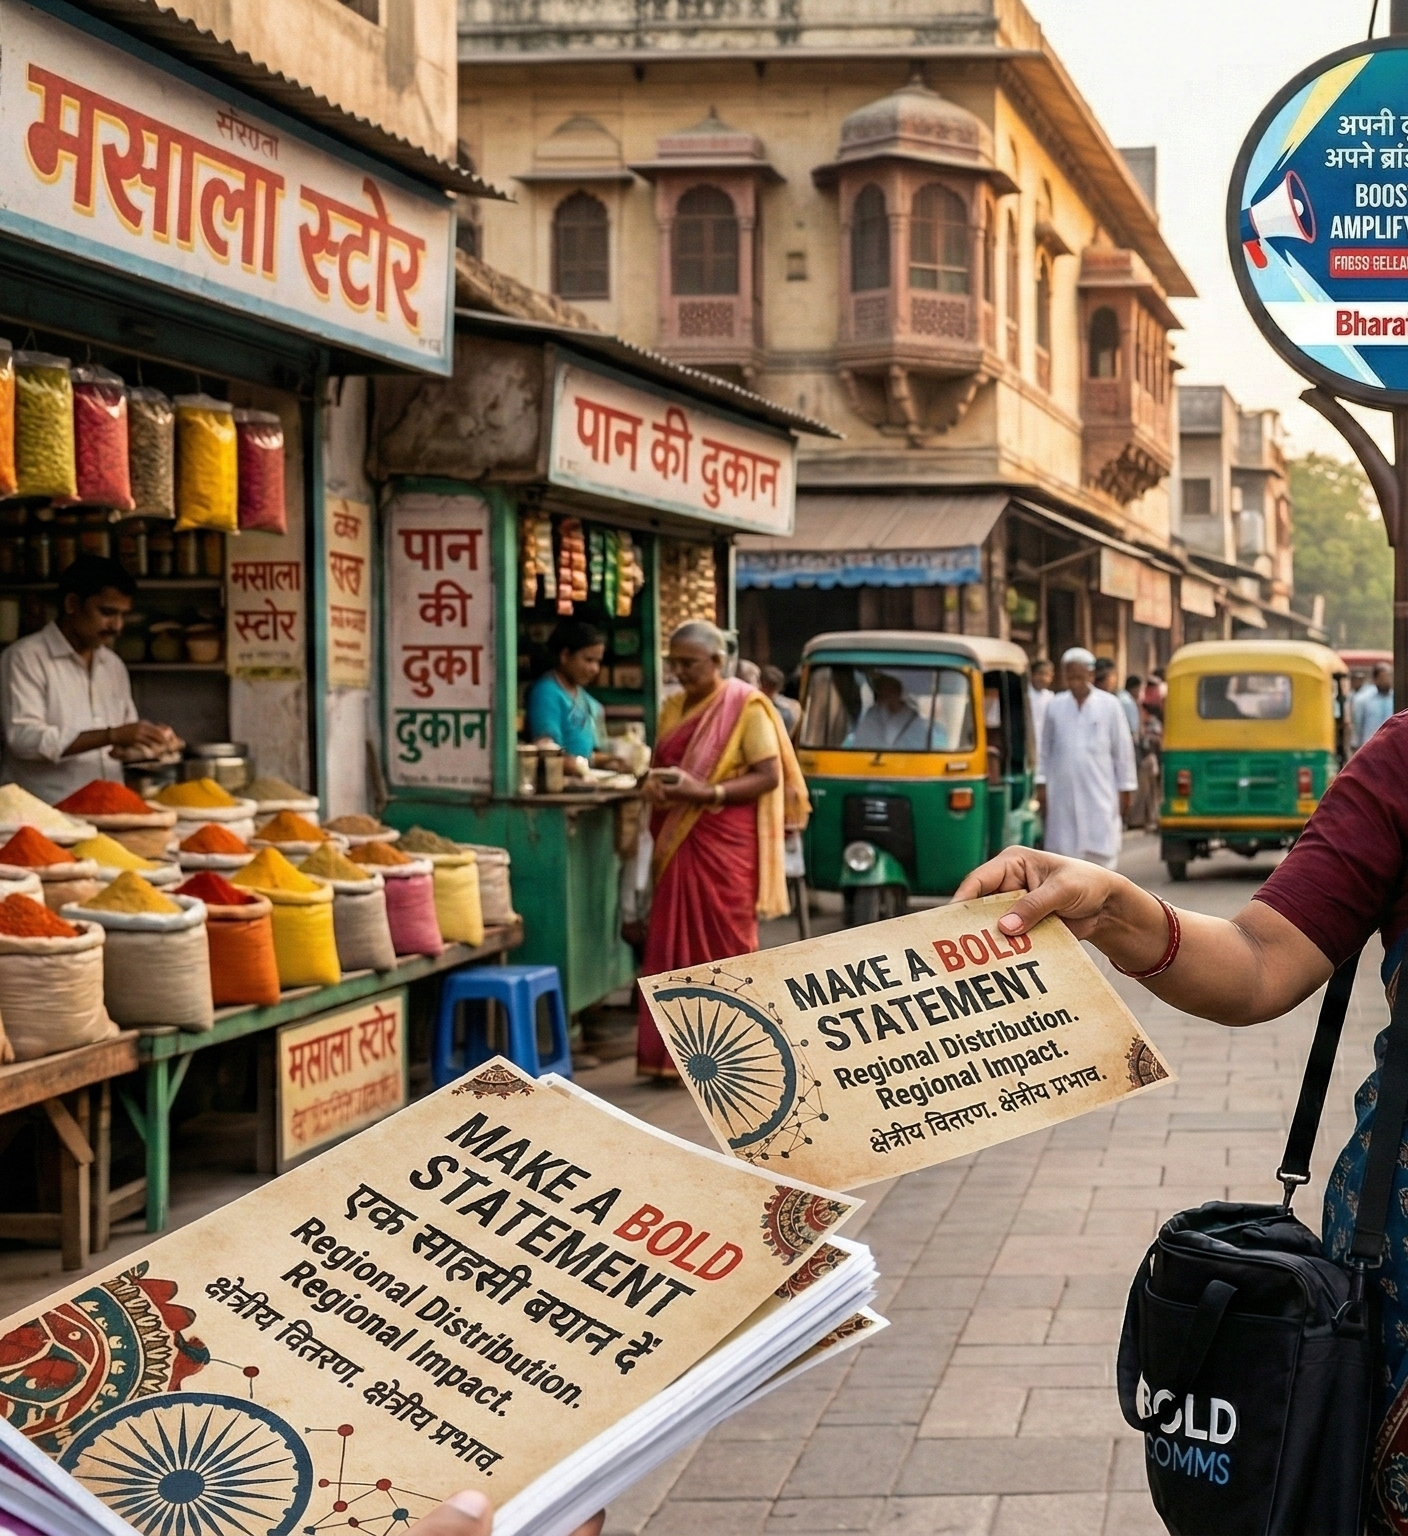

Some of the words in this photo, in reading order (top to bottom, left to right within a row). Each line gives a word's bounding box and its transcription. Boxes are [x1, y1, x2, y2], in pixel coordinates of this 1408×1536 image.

[1324, 141, 1375, 169] अपने
[1337, 107, 1396, 136] अपनी
[26, 63, 285, 281] मसाला
[299, 177, 426, 334] स्टोर
[574, 396, 643, 472] पान
[651, 405, 693, 484] की
[701, 437, 781, 509] दुकान
[231, 561, 301, 592] मसाला
[398, 528, 483, 571] पान
[234, 598, 297, 642] स्टोर
[418, 580, 473, 628] की
[402, 645, 484, 698] दुका
[394, 708, 491, 763] दुकान
[784, 954, 902, 1011] MAKE
[904, 948, 937, 982] A
[932, 929, 1033, 973] BOLD
[817, 960, 1050, 1052] STATEMENT
[288, 1026, 353, 1088] मसाला
[358, 1005, 397, 1067] स्टोर
[833, 1041, 940, 1090] Regional
[939, 1006, 1080, 1059] Distribution.
[876, 1061, 982, 1111] Regional
[986, 1040, 1069, 1078] Impact.
[869, 1121, 926, 1155] क्षेत्रीय
[924, 1102, 998, 1136] वितरण.
[1049, 1066, 1108, 1096] प्रभाव.
[410, 1155, 697, 1318] STATEMENT
[445, 1112, 592, 1204] MAKE
[571, 1187, 623, 1226] A
[613, 1204, 744, 1282] BOLD
[290, 1217, 428, 1309] Regional
[415, 1295, 584, 1410] Distribution.
[346, 1183, 418, 1235] एक
[412, 1224, 533, 1306] साहसी
[523, 1288, 626, 1356] बयान
[615, 1331, 664, 1375] दें
[205, 1276, 285, 1331] क्षेत्रीय
[274, 1319, 365, 1388] वितरण.
[363, 1378, 439, 1432] क्षेत्रीय
[428, 1419, 505, 1477] प्रभाव.
[280, 1260, 419, 1352] Regional
[406, 1339, 507, 1417] Impact.
[1136, 1371, 1237, 1445] BOLD
